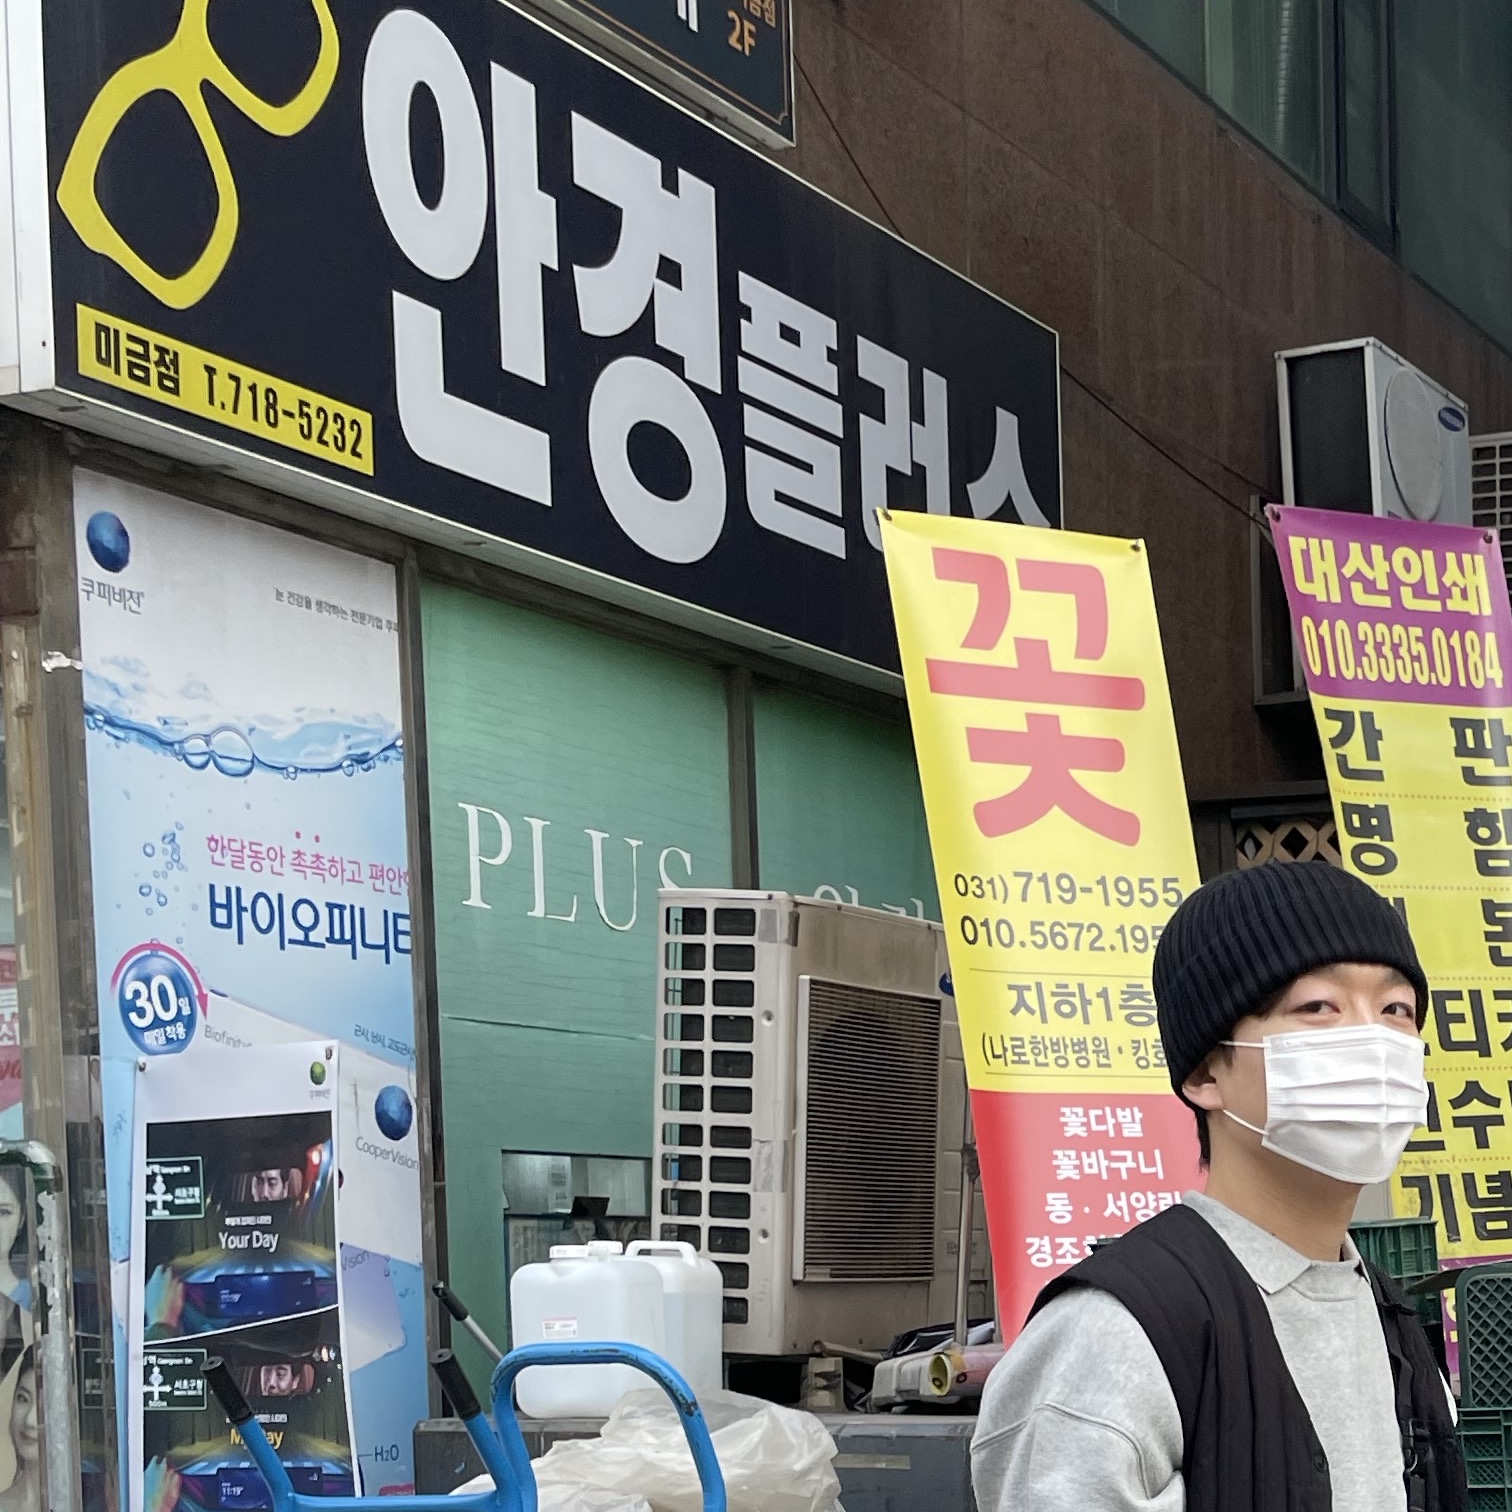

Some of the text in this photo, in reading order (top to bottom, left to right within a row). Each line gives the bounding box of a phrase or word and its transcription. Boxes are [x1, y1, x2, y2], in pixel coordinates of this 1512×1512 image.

[727, 9, 757, 57] 2F
[362, 9, 1052, 565] 안경플러스
[94, 321, 363, 460] 미금점 T.718-5232
[1288, 535, 1492, 616] 대산인쇄
[1301, 615, 1504, 690] 010.3335.0184
[925, 546, 1146, 847] 꽃
[206, 834, 409, 896] 한달동안 촉촉하고 편안
[1007, 981, 1157, 1027] 지하1층
[1059, 1106, 1144, 1138] 꽃다발
[355, 1136, 420, 1170] CooperVision
[1052, 1149, 1165, 1181] 꽃바구니
[218, 1230, 280, 1253] Your Day
[374, 1445, 400, 1463] H2O
